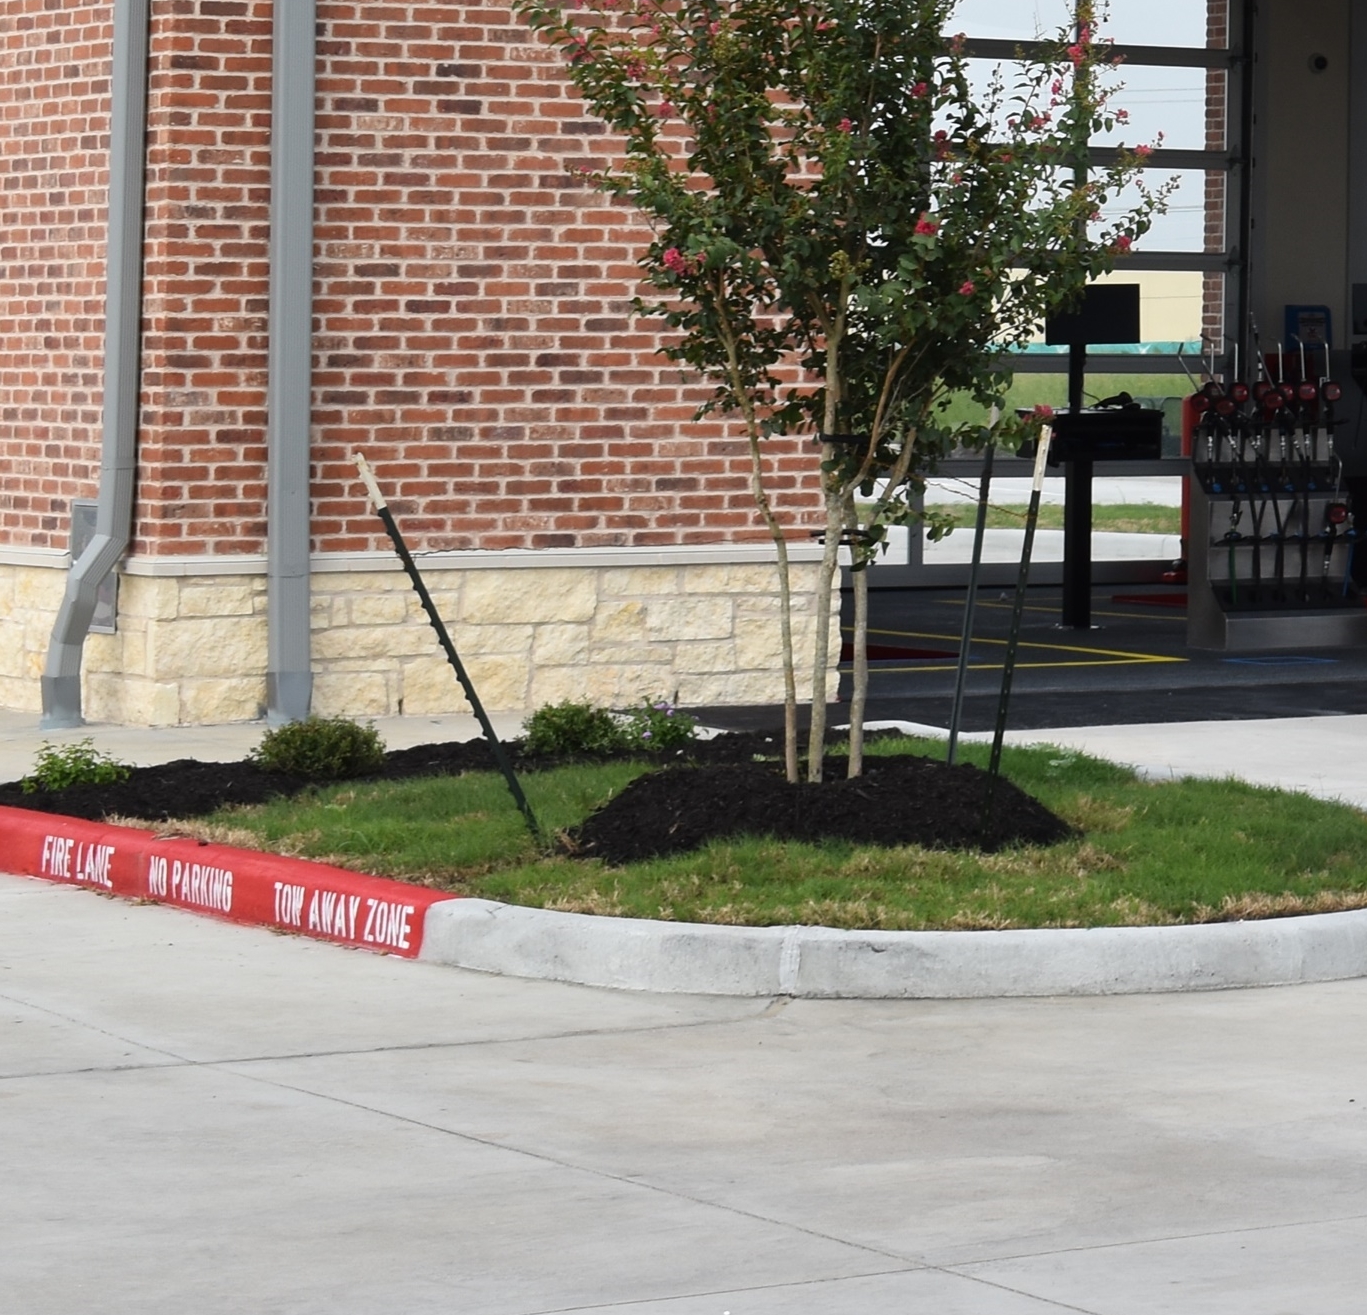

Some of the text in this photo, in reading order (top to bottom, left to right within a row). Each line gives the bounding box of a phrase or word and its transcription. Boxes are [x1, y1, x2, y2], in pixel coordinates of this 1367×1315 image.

[42, 835, 115, 888] FIRE LANE
[150, 855, 233, 912] NO PARKING
[274, 882, 415, 950] TOW AWAY ZONE
